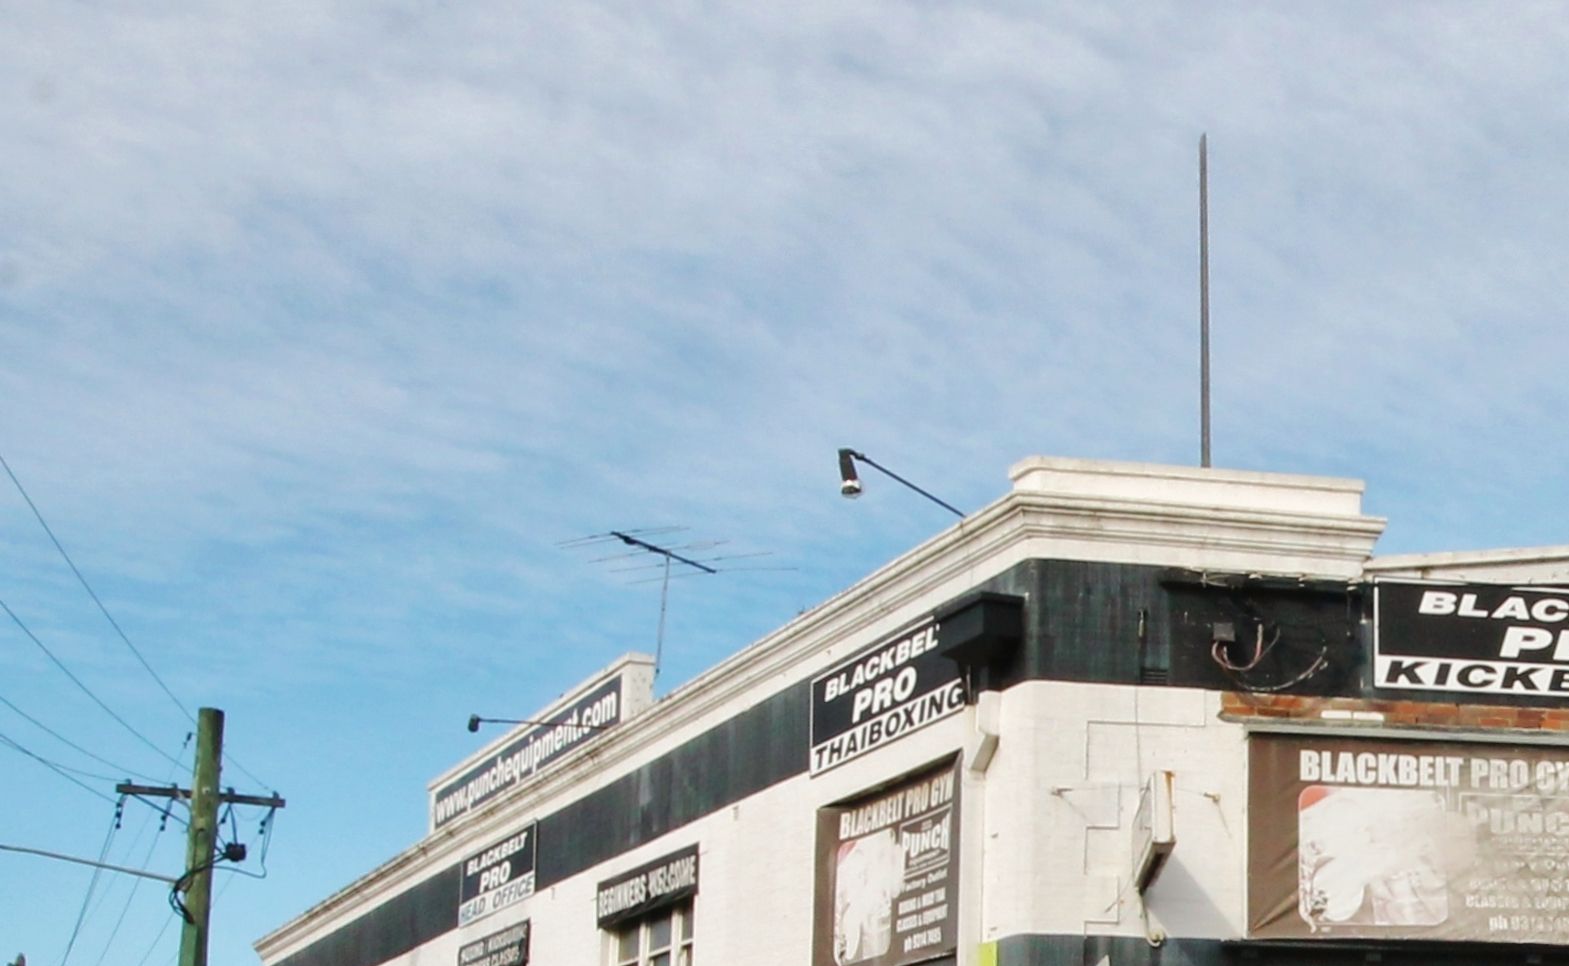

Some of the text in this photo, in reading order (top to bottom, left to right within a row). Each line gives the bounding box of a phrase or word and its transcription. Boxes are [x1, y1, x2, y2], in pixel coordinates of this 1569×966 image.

[824, 623, 941, 702] BLACKBEL
[852, 665, 918, 724] PRO
[815, 683, 964, 770] THAIBOXING
[435, 691, 617, 824] www.punchequipment.com
[1300, 749, 1465, 788] BLACKBELT
[1470, 758, 1529, 789] PRO
[839, 793, 903, 840] BLACKBELT
[905, 781, 930, 817] PRO
[902, 811, 949, 858] PUNCH
[466, 832, 528, 877] BLACKBELT
[479, 861, 512, 894] PRO
[492, 874, 534, 909] OFFICE
